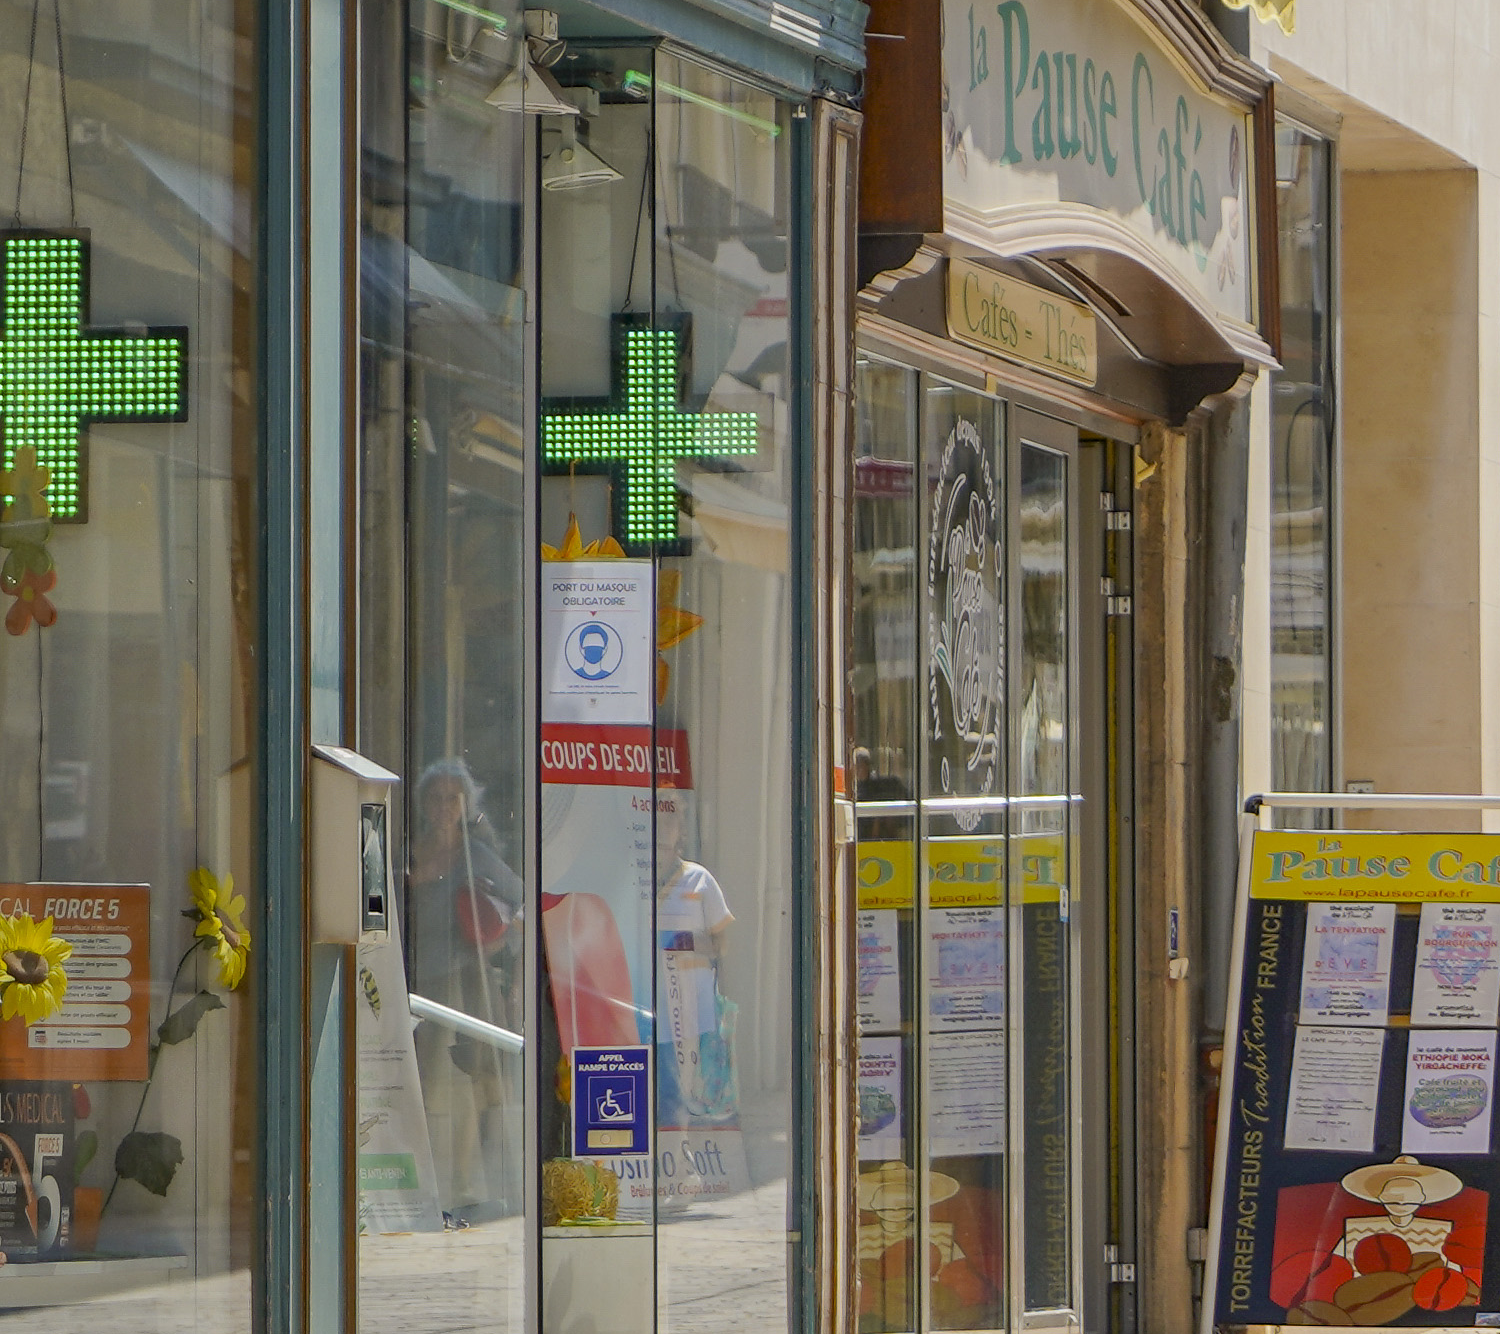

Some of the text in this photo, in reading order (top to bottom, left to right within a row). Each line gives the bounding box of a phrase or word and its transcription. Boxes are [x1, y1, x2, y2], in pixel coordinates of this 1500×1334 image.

[968, 0, 1208, 275] la Pause Café
[962, 270, 1019, 349] Cafés
[1039, 299, 1089, 373] Thés
[552, 583, 637, 594] PORT DU MASQUE
[562, 597, 626, 606] OBLIGATOIRE
[541, 740, 598, 771] COUPS
[599, 743, 624, 771] DE
[631, 794, 638, 811] 4
[1263, 850, 1412, 884] Pause
[1302, 887, 1475, 899] www.lapausecafe.fr
[43, 898, 106, 920] FORCE
[107, 899, 120, 920] 5
[1331, 926, 1386, 935] TENTATION
[1257, 904, 1284, 989] FRANCE
[578, 1063, 608, 1072] RAMPE
[598, 1053, 625, 1063] APPEL
[1240, 992, 1271, 1129] Tradition
[1412, 1053, 1491, 1062] ETHIOPIE MOKA
[16, 1093, 66, 1124] MEDICAL
[681, 1139, 727, 1182] Soft
[1229, 1130, 1265, 1313] TORREFACTEURS
